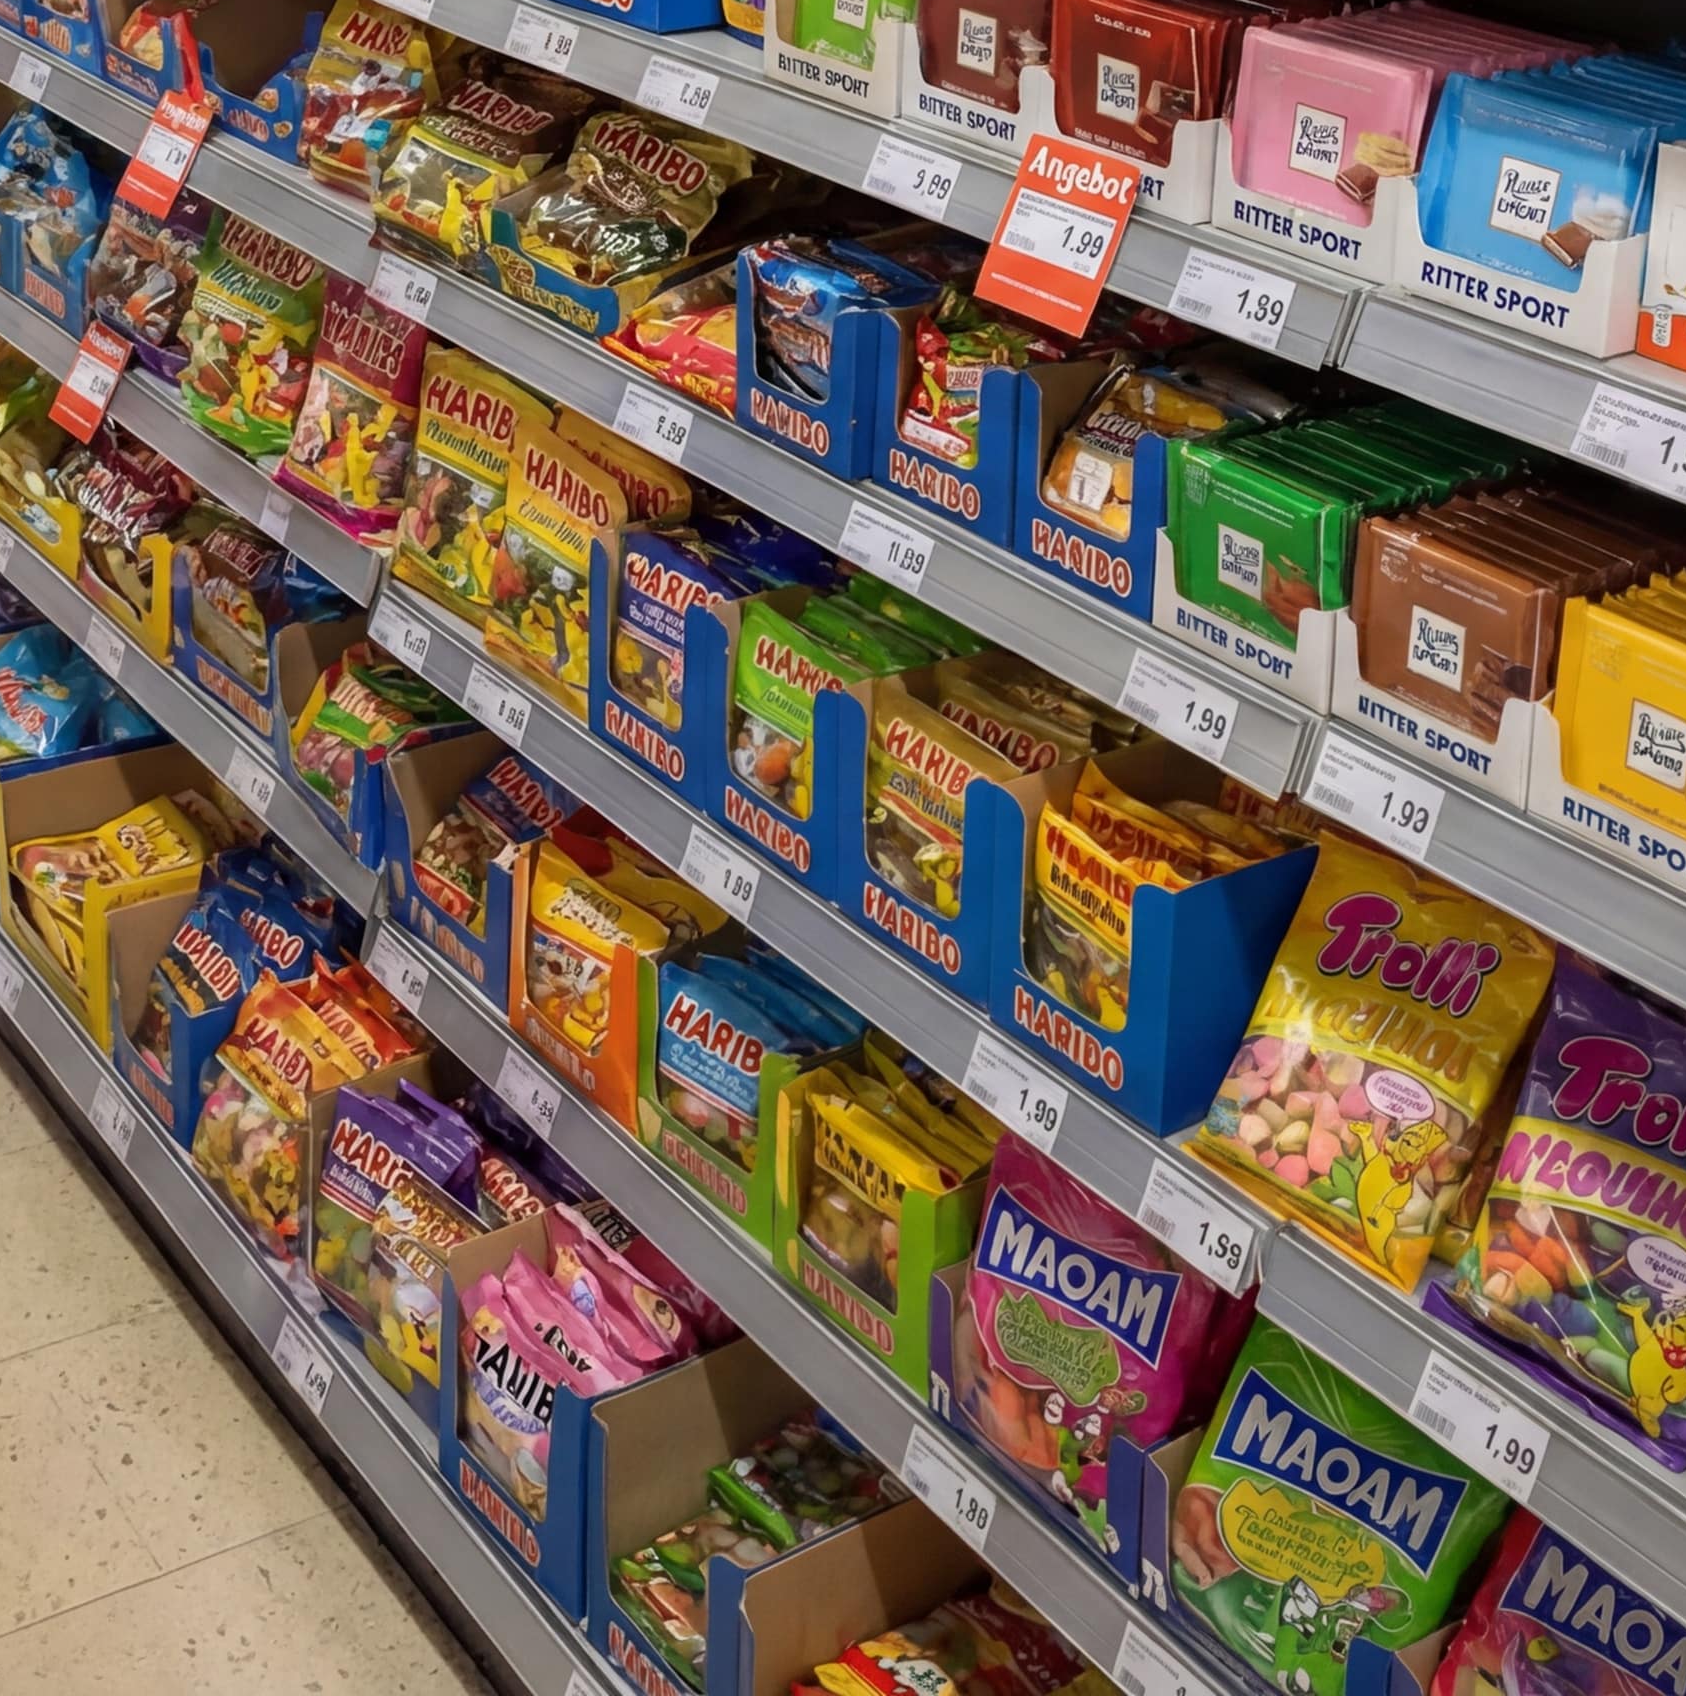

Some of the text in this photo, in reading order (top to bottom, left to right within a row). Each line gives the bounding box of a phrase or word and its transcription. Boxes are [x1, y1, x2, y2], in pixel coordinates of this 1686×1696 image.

[1061, 225, 1104, 259] 1.99
[1299, 222, 1363, 263] SPORT
[1420, 261, 1571, 330] RITTER SPORT
[425, 375, 516, 452] HARIB
[524, 447, 611, 528] HARIBO
[883, 716, 989, 797] HARIB
[1183, 700, 1227, 741] 1.99
[1424, 730, 1492, 777] SPORT
[1317, 892, 1501, 1018] Trolli
[665, 990, 767, 1078] HARIB
[987, 1209, 1166, 1349] MAOAM
[1230, 1392, 1449, 1553] MAOAM
[1484, 1421, 1538, 1475] 1,99
